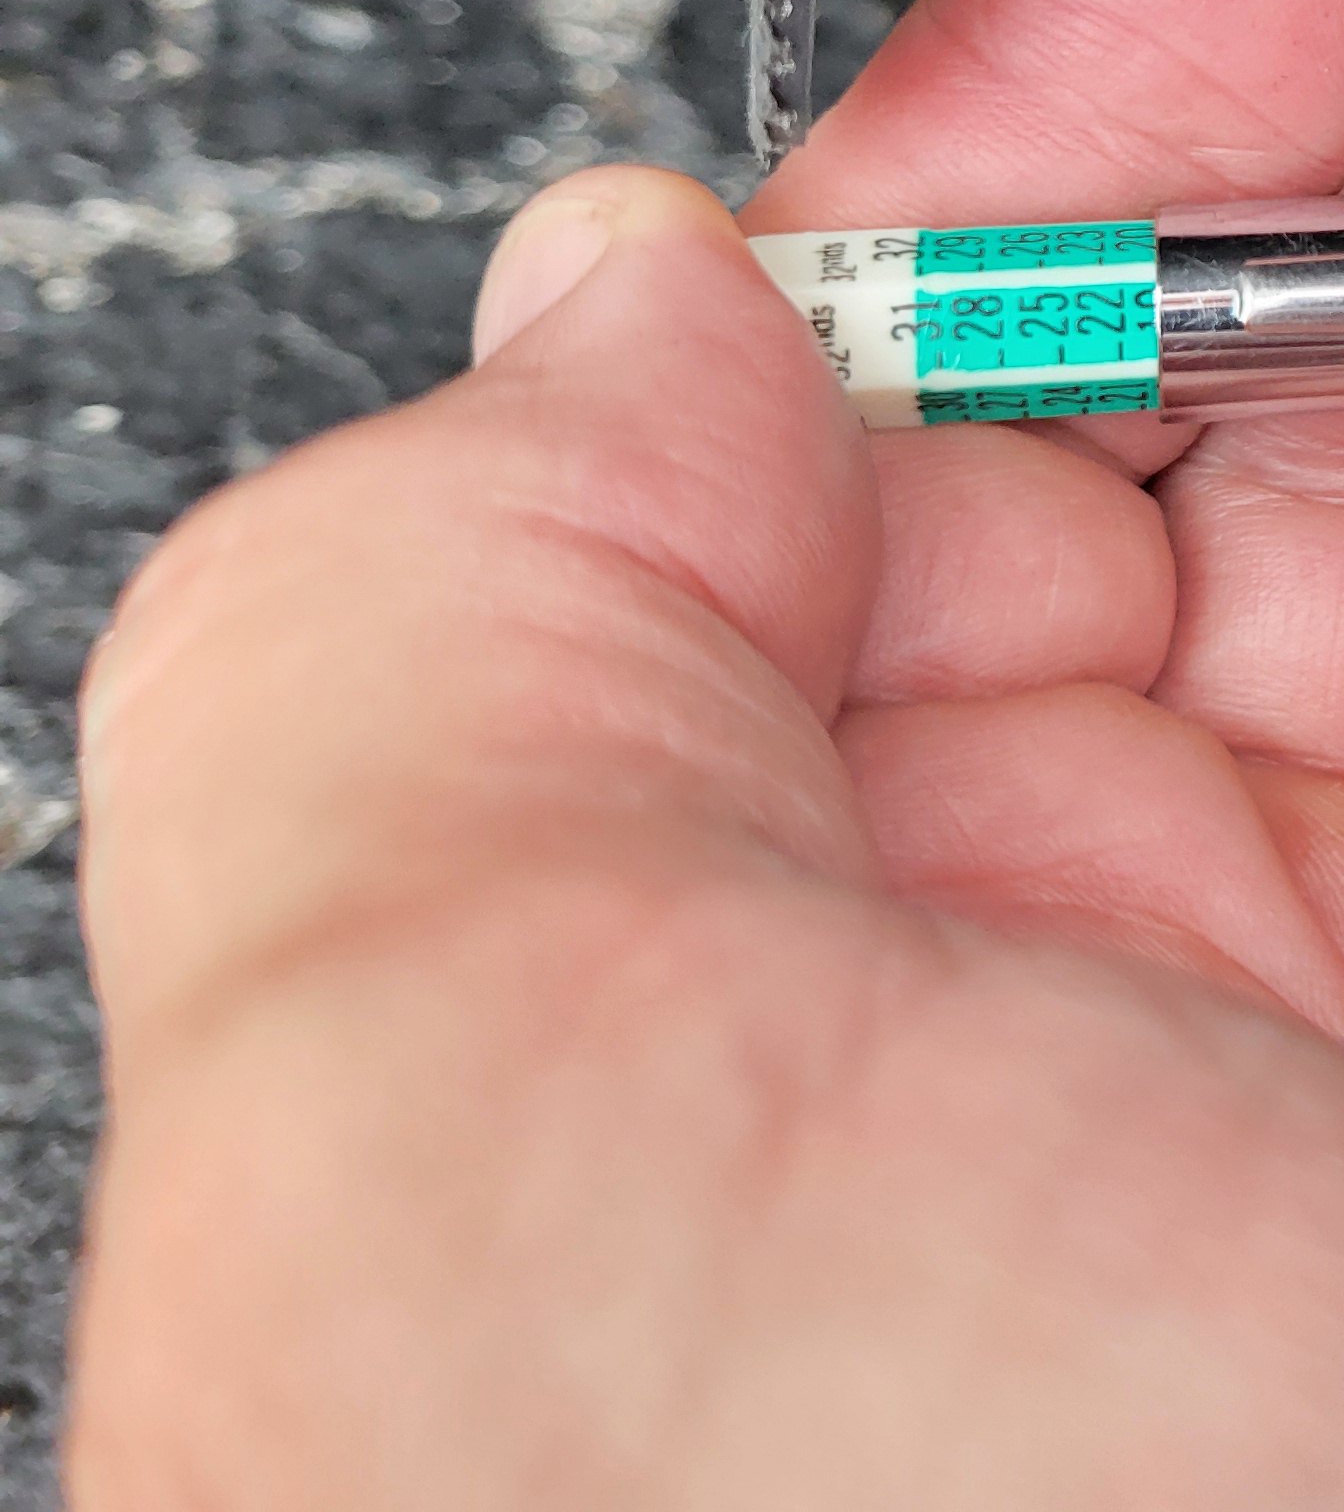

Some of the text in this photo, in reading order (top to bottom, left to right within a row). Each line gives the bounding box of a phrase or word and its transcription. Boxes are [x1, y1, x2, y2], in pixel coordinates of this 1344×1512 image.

[873, 237, 925, 261] 32
[935, 236, 984, 259] 29
[1001, 232, 1049, 256] 26
[1056, 230, 1105, 253] 23
[1115, 227, 1156, 251] 20
[890, 298, 943, 342] 31
[951, 295, 1004, 341] 28
[1018, 292, 1069, 338] 25
[1075, 288, 1124, 335] 22
